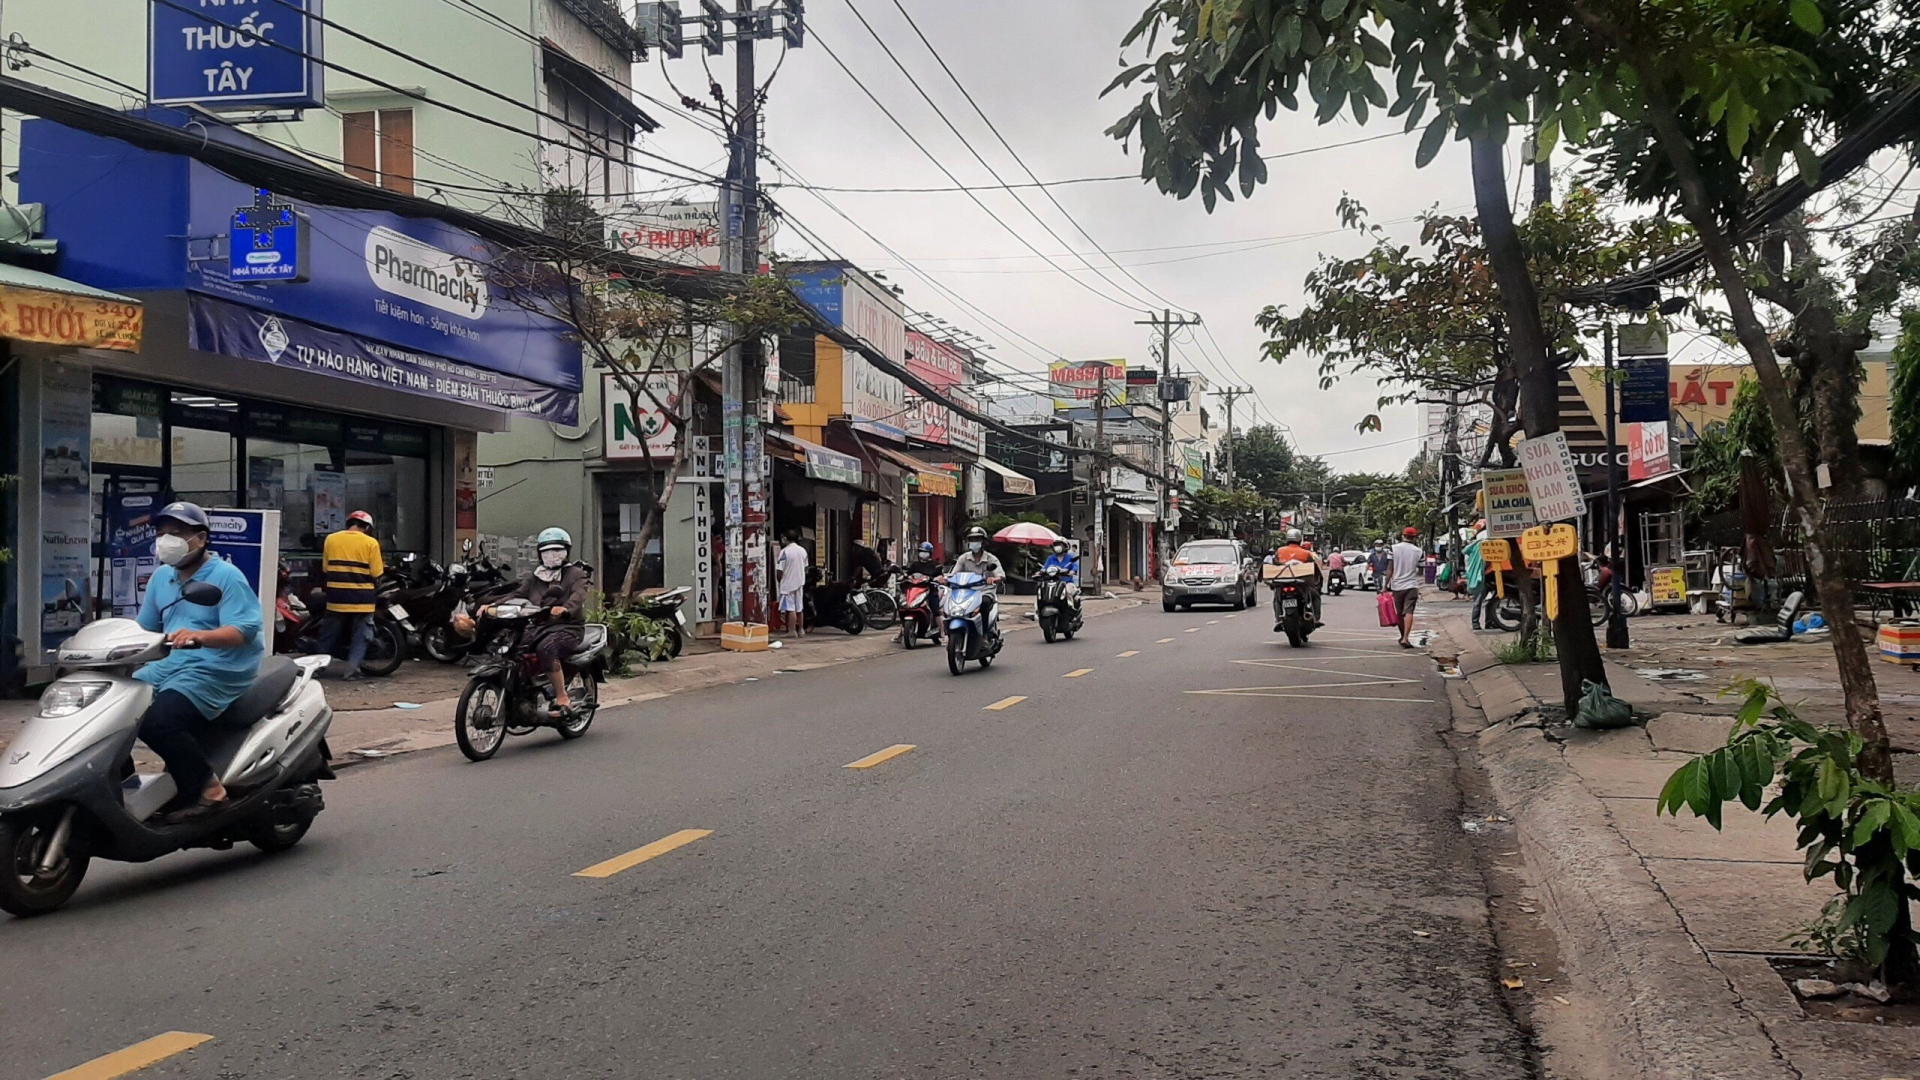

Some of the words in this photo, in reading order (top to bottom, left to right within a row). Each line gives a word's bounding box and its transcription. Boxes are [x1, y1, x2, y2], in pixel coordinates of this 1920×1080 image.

[182, 11, 275, 51] THUỐC
[203, 61, 253, 92] TÂY
[232, 265, 250, 276] NHÀ
[251, 263, 277, 275] THUỐC
[279, 263, 293, 274] TÂY
[376, 244, 479, 313] Pharmacity
[17, 299, 86, 341] BƯỞI
[95, 301, 137, 319] 340
[374, 299, 388, 315] Tiết
[390, 303, 409, 322] kiệm
[410, 309, 425, 325] hơn
[431, 315, 449, 336] Sống
[449, 321, 467, 338] khỏe
[467, 327, 480, 342] hơn
[296, 345, 315, 368] TỰ
[317, 348, 344, 371] HÀO
[346, 355, 379, 379] HÀNG
[381, 364, 404, 387] VIỆT
[406, 371, 429, 390] NAM
[435, 377, 459, 396] ĐIỂM
[460, 381, 479, 401] BÁN
[481, 387, 510, 407] THUỐC
[388, 348, 405, 361] NHÂN
[417, 356, 435, 370] THÀNH
[1050, 365, 1125, 383] MASSAGE
[1525, 442, 1552, 461] SỬA
[697, 577, 708, 618] TÂY
